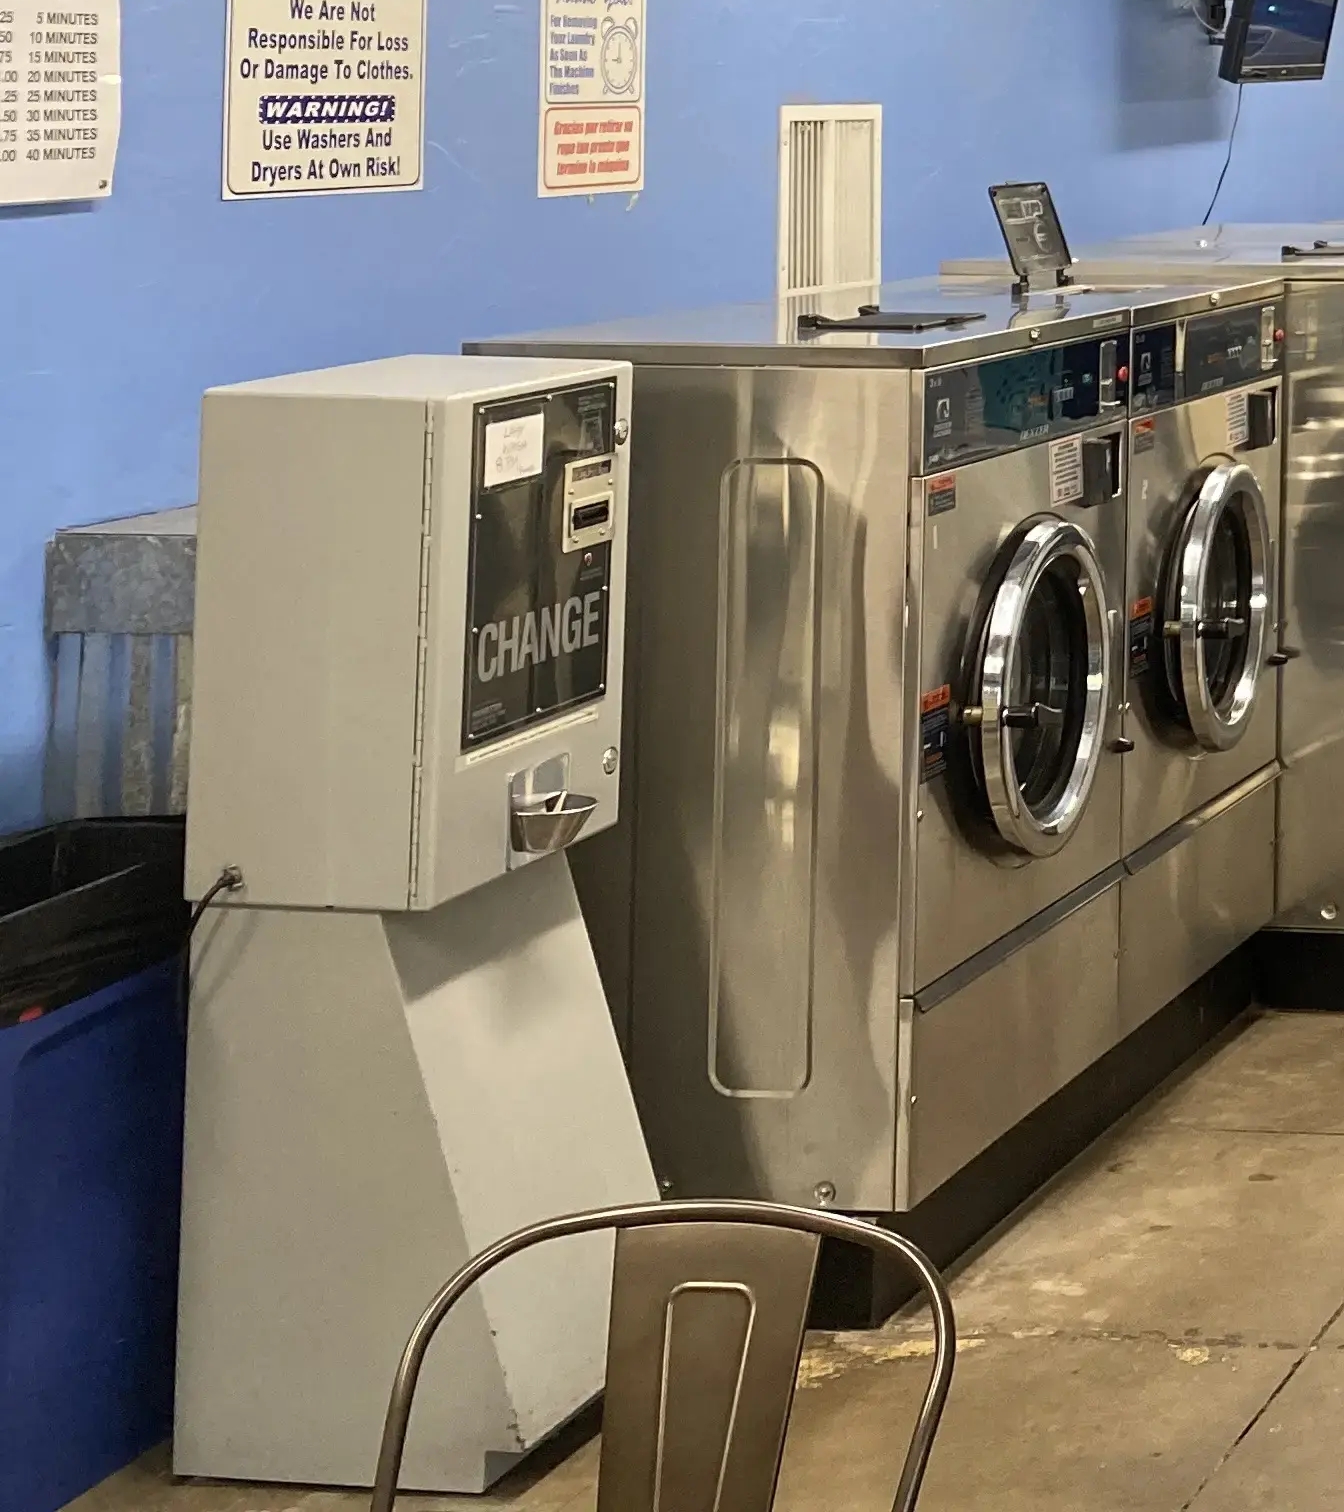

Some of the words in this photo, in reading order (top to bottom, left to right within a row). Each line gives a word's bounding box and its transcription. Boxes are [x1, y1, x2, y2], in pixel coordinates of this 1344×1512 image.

[319, 0, 345, 20] Are
[351, 1, 376, 21] Not
[36, 12, 44, 24] 5
[47, 12, 98, 26] MINUTES
[29, 32, 42, 44] 10
[45, 32, 97, 45] MINUTES
[248, 27, 345, 54] Responsible
[350, 30, 373, 50] For
[377, 31, 409, 51] Loss
[29, 51, 41, 64] 15
[44, 51, 97, 64] MINUTES
[27, 70, 41, 83] 20
[44, 70, 97, 83] MINUTES
[240, 58, 259, 79] Or
[264, 58, 329, 84] Damage
[334, 59, 351, 80] To
[356, 59, 413, 80] Clothes.
[27, 90, 41, 103] 25
[44, 89, 97, 103] MINUTES
[26, 109, 40, 123] 30
[43, 108, 97, 122] MINUTES
[266, 100, 389, 118] WARNING!
[26, 129, 40, 142] 35
[43, 127, 97, 141] MINUTES
[262, 129, 292, 150] Use
[297, 128, 360, 150] Washers
[365, 127, 392, 148] And
[26, 148, 40, 161] 40
[42, 147, 96, 161] MINUTES
[251, 161, 302, 187] Dryers
[307, 159, 324, 180] At
[329, 158, 361, 178] Own
[366, 155, 401, 177] Risk!
[478, 591, 600, 683] CHANGE
